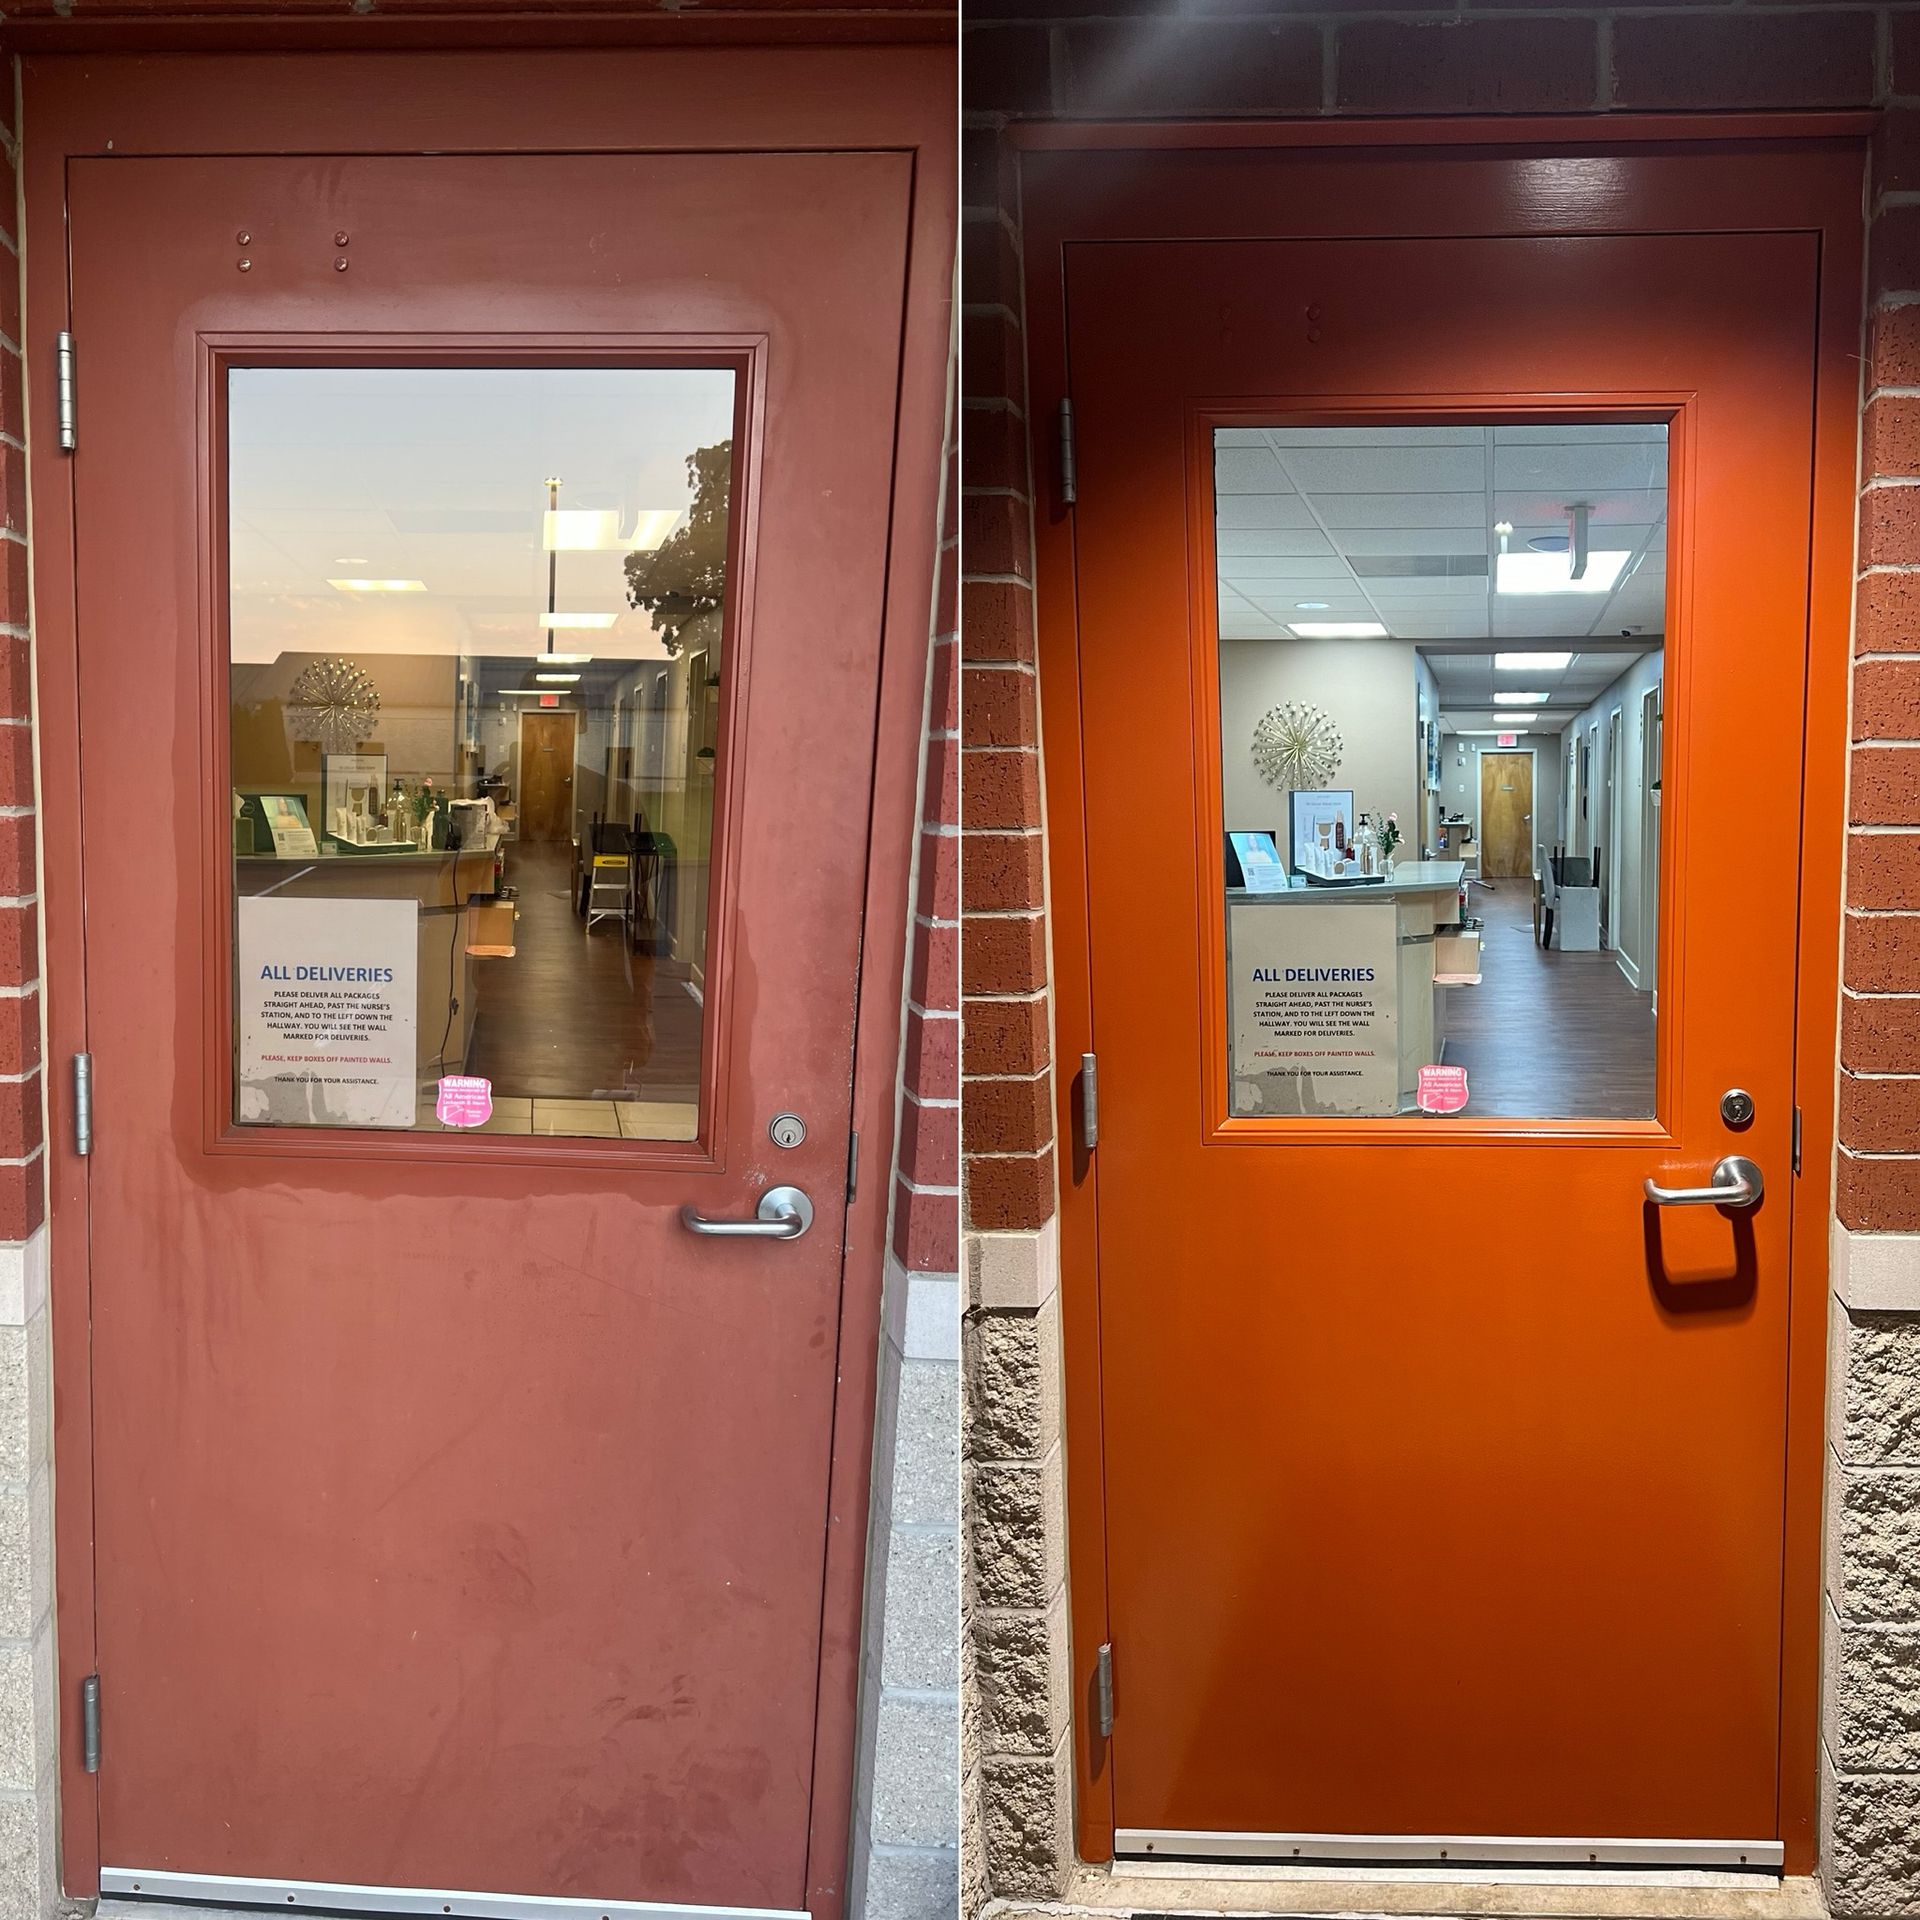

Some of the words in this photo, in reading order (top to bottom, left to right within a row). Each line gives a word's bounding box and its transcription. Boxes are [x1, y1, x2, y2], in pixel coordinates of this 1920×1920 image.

[260, 965, 291, 980] ALL
[296, 966, 393, 982] DELIVERIES
[1253, 968, 1281, 981] ALL
[1285, 968, 1375, 981] DELIVERIES
[1423, 1068, 1462, 1076] WARNING
[444, 1078, 486, 1088] WARNING
